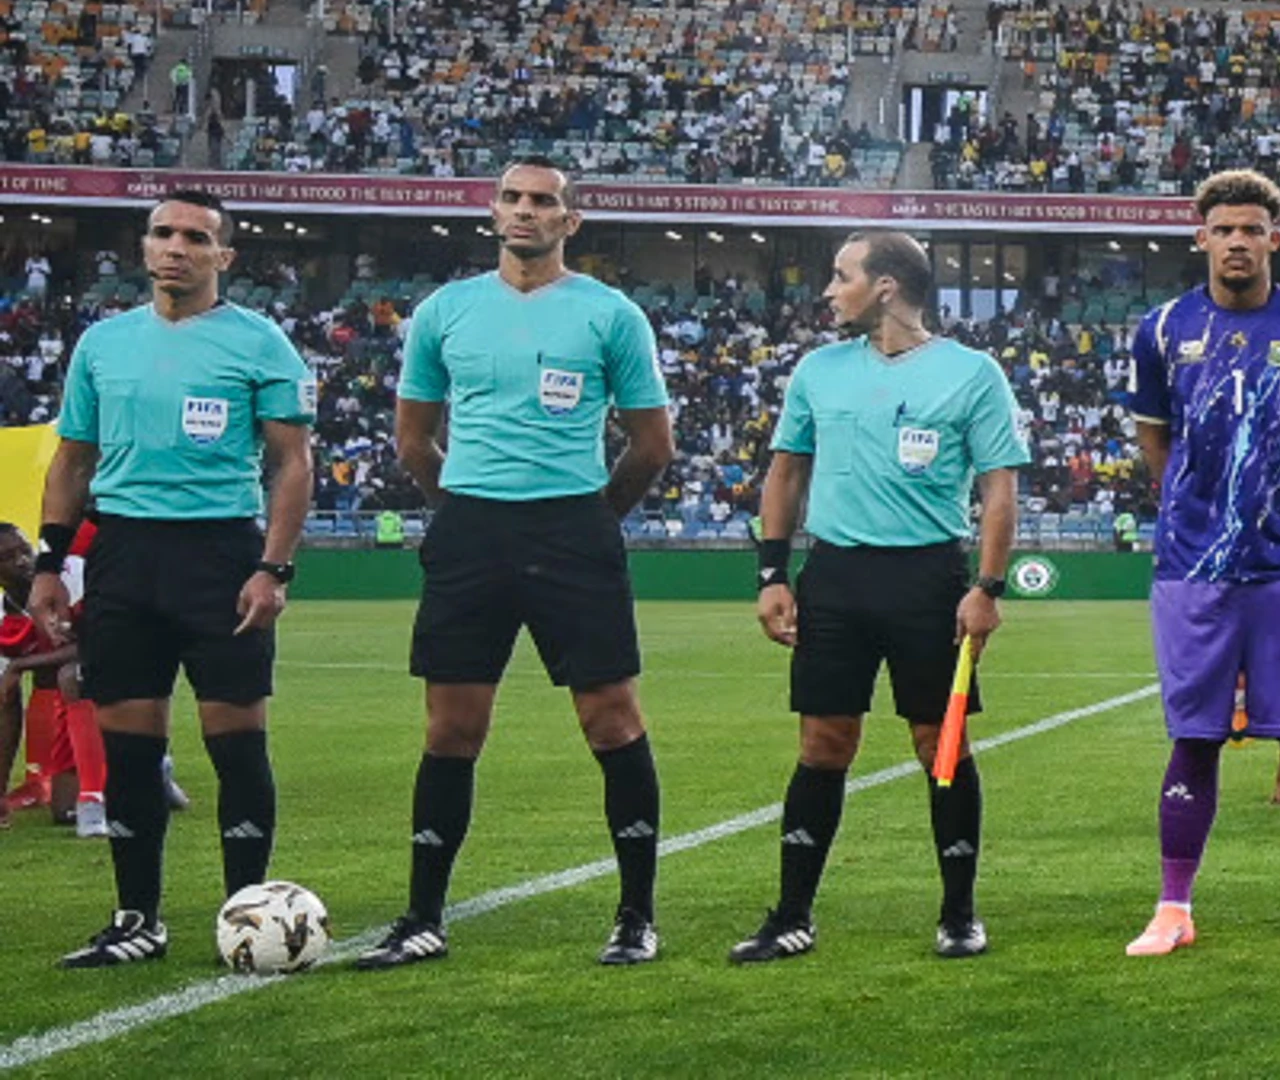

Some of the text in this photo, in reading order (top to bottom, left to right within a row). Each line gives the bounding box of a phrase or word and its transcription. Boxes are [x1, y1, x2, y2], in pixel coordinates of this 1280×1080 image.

[34, 177, 68, 192] TIME
[205, 183, 246, 197] TASTE
[596, 194, 634, 208] TASTE
[1231, 369, 1245, 415] 1
[187, 401, 224, 415] FIFA
